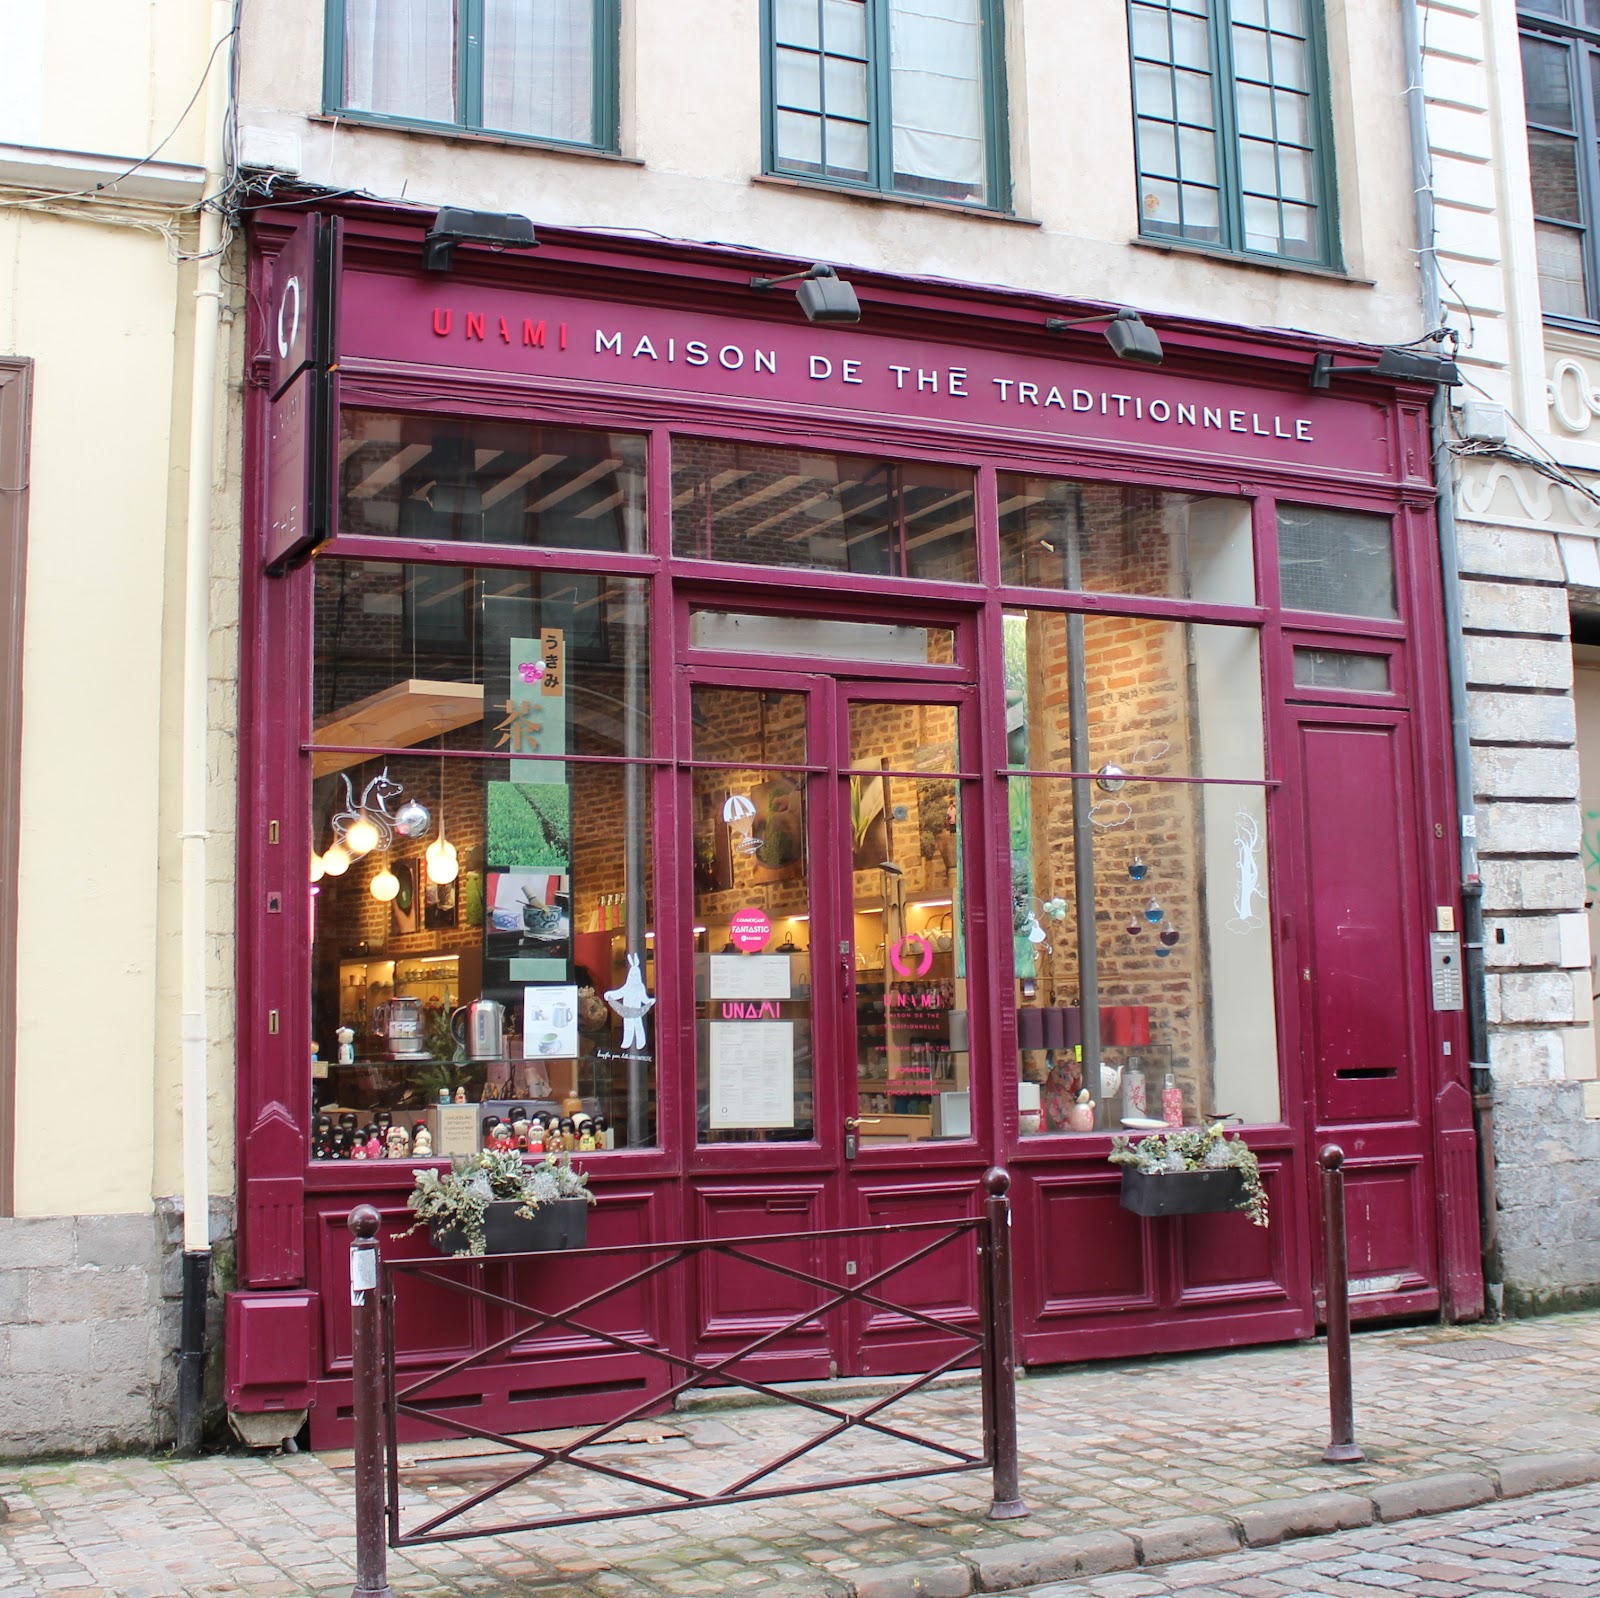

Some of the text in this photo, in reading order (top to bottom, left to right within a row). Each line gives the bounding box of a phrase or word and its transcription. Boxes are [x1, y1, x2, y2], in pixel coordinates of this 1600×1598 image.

[595, 329, 777, 374] MAISON
[809, 355, 863, 383] DE
[992, 377, 1315, 442] TRADITIONNELLE
[492, 700, 542, 750] 茶
[732, 925, 770, 934] FANTASTIC
[722, 1002, 781, 1019] UNAMI
